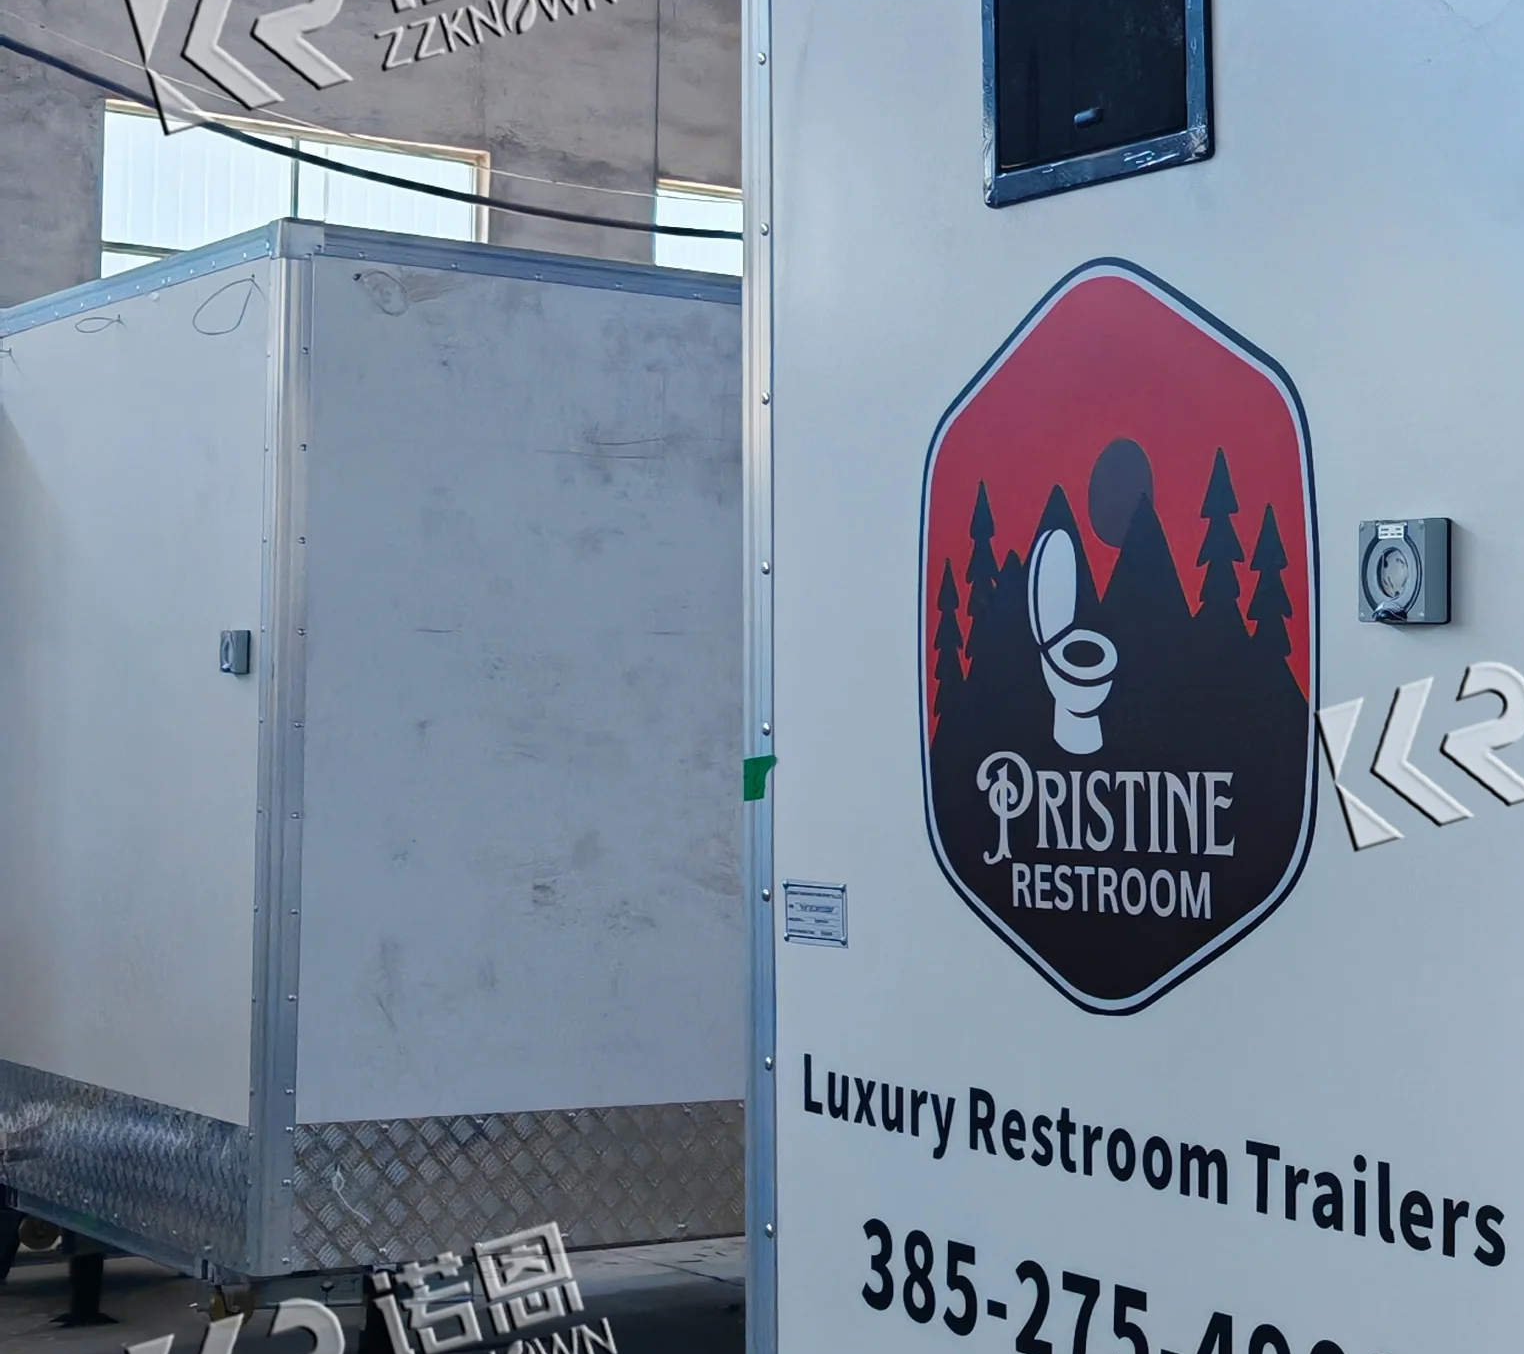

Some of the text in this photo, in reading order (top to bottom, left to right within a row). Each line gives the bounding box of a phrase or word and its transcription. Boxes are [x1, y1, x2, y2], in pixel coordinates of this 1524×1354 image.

[976, 751, 1236, 865] PRISTINE
[1012, 862, 1212, 920] RESTROOM
[803, 1053, 1506, 1267] Luxury Restroom Trailers
